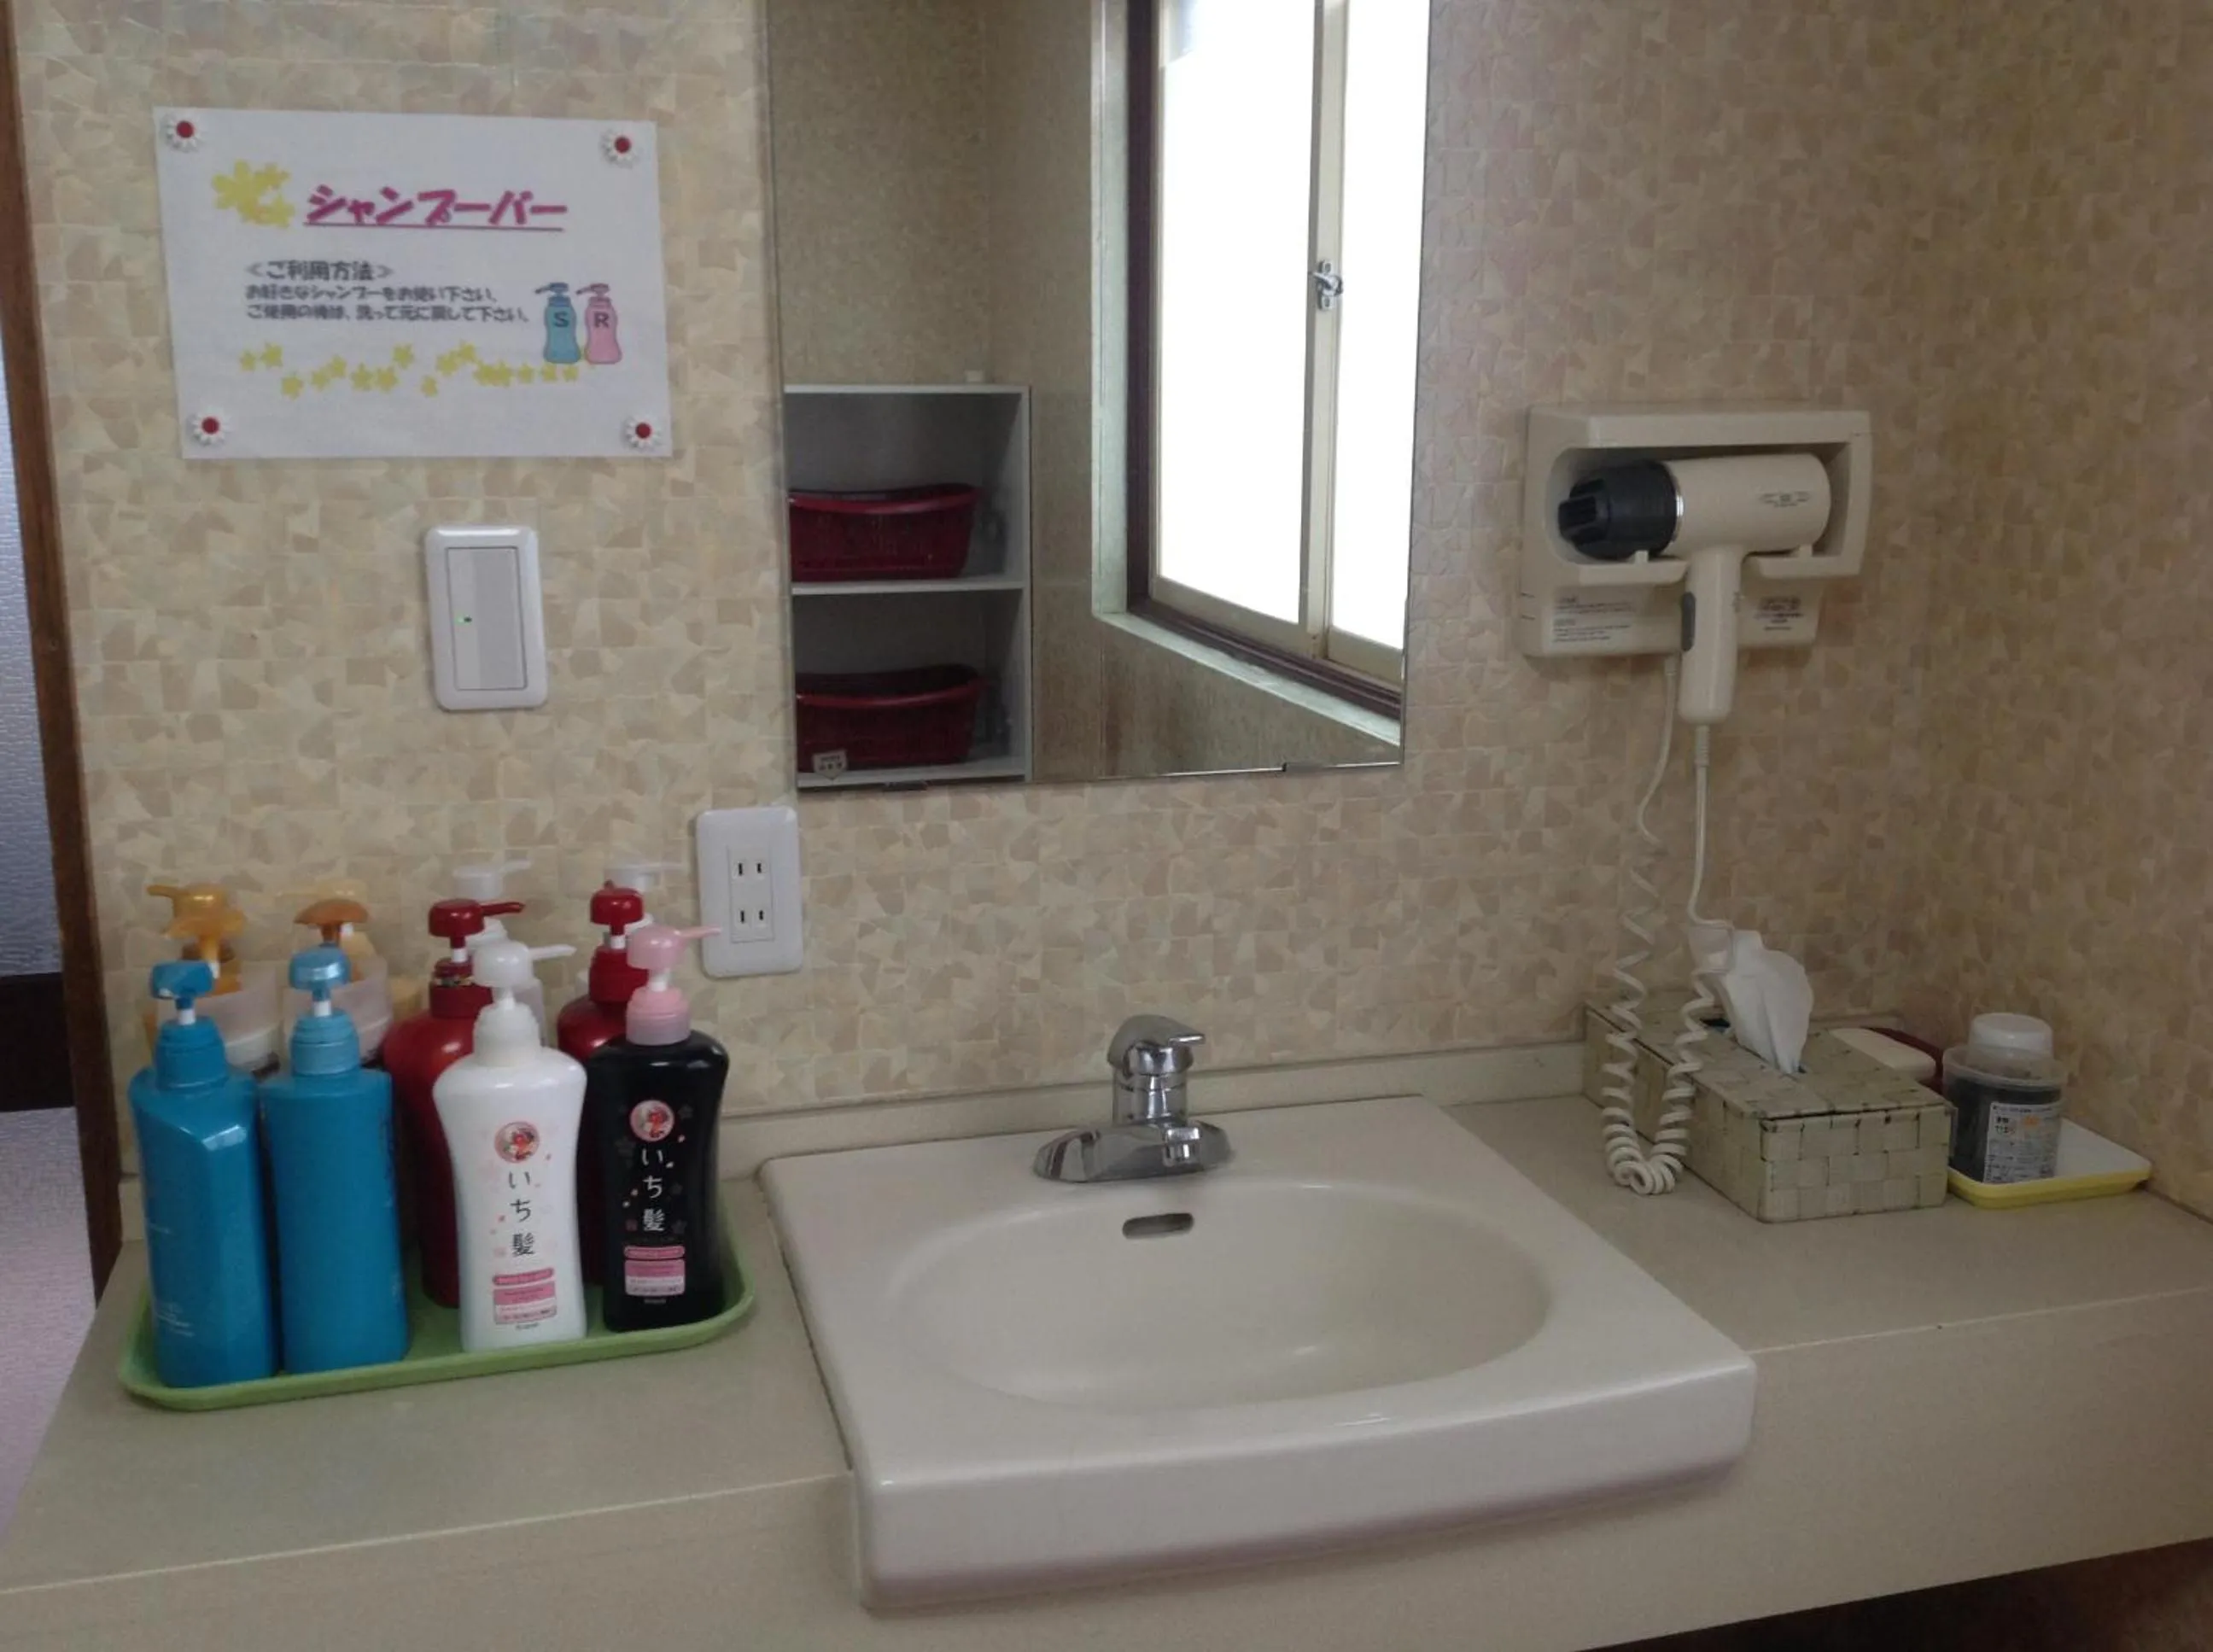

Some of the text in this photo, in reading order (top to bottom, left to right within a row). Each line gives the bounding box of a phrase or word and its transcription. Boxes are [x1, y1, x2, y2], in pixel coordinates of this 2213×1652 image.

[307, 184, 568, 226] シャンプーバー
[553, 310, 570, 328] S
[593, 311, 610, 329] R
[641, 1148, 666, 1232] いち髪
[508, 1170, 535, 1256] いち髪
